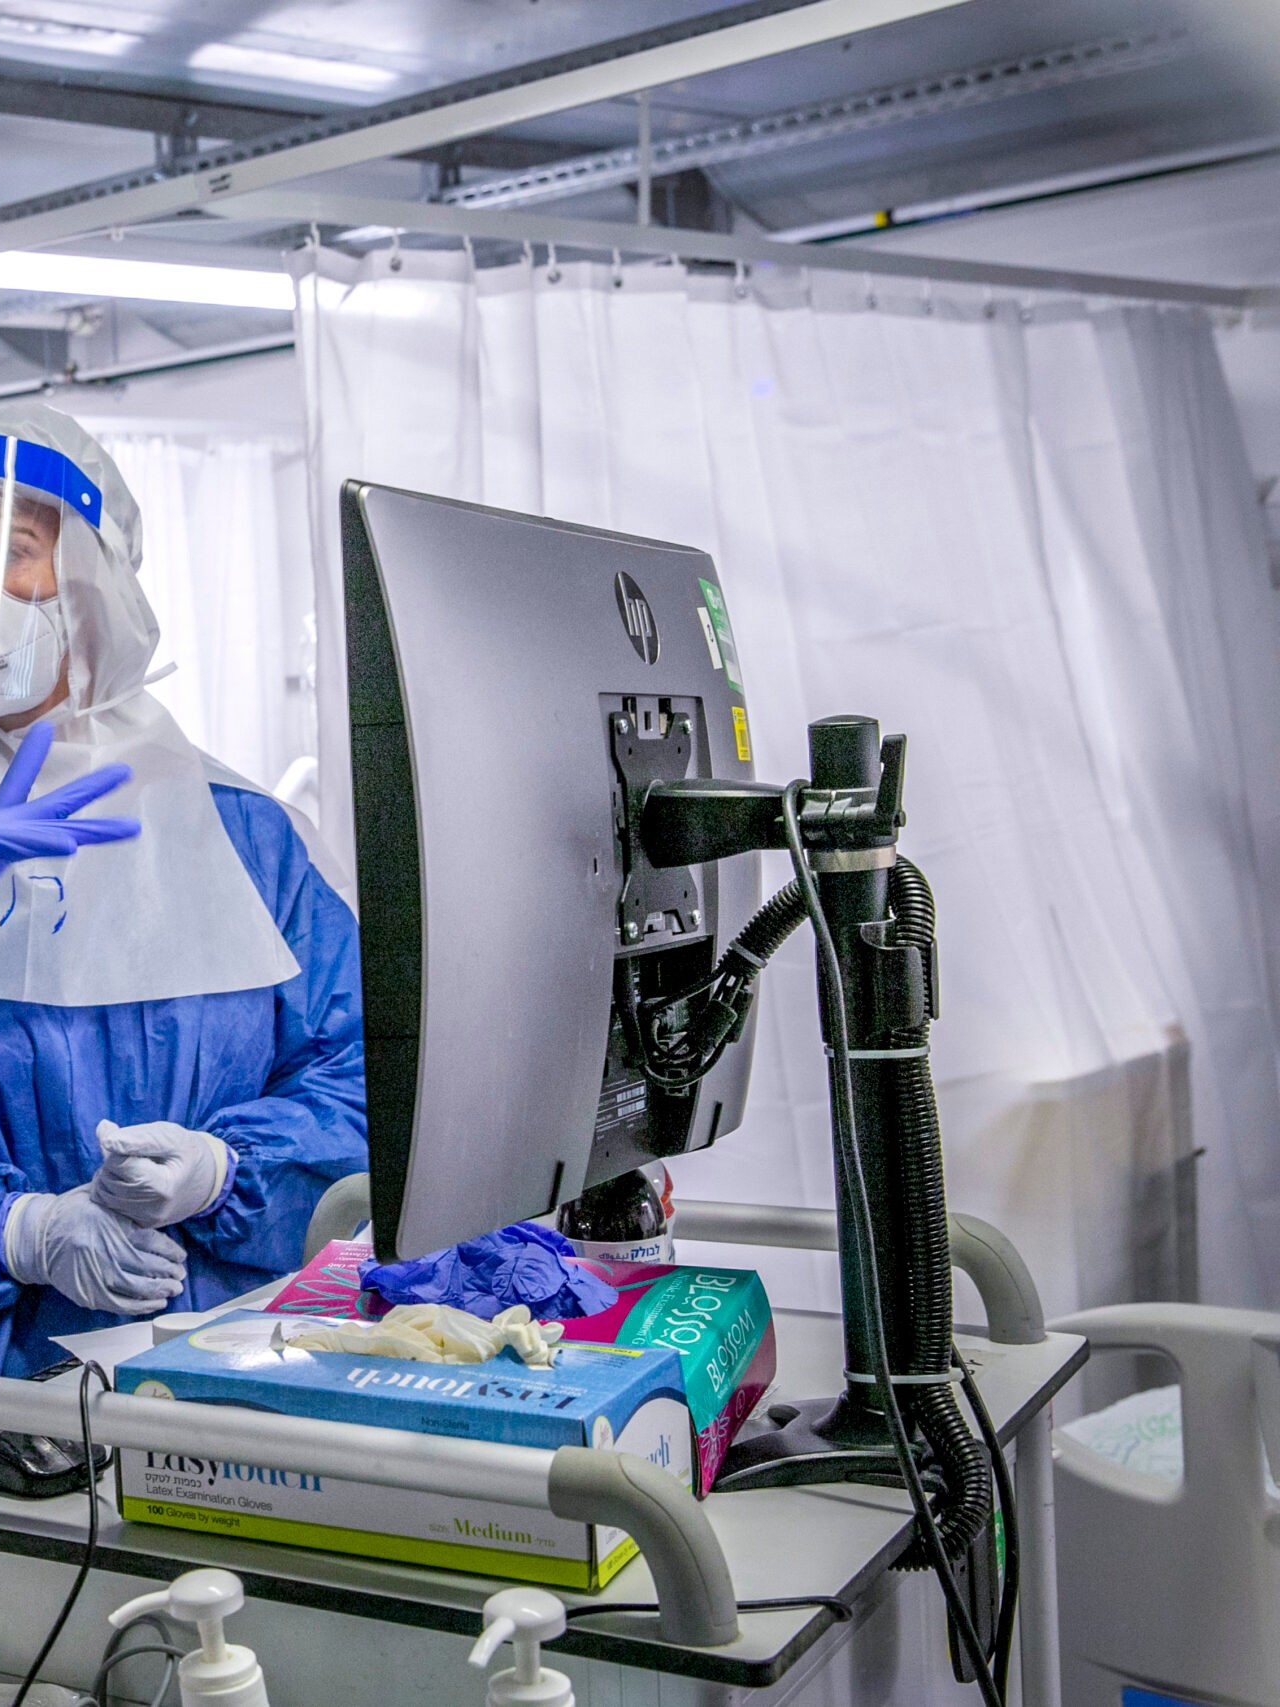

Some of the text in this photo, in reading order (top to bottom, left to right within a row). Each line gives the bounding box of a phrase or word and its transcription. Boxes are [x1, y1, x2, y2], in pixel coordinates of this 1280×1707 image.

[631, 1243, 661, 1260] לבולק
[706, 1308, 755, 1393] BLOSSOM
[144, 1472, 171, 1484] לטקס
[146, 1484, 273, 1512] Latex Examination Gloves
[147, 1505, 240, 1528] 100 Gloves by weight
[453, 1518, 532, 1544] Medium
